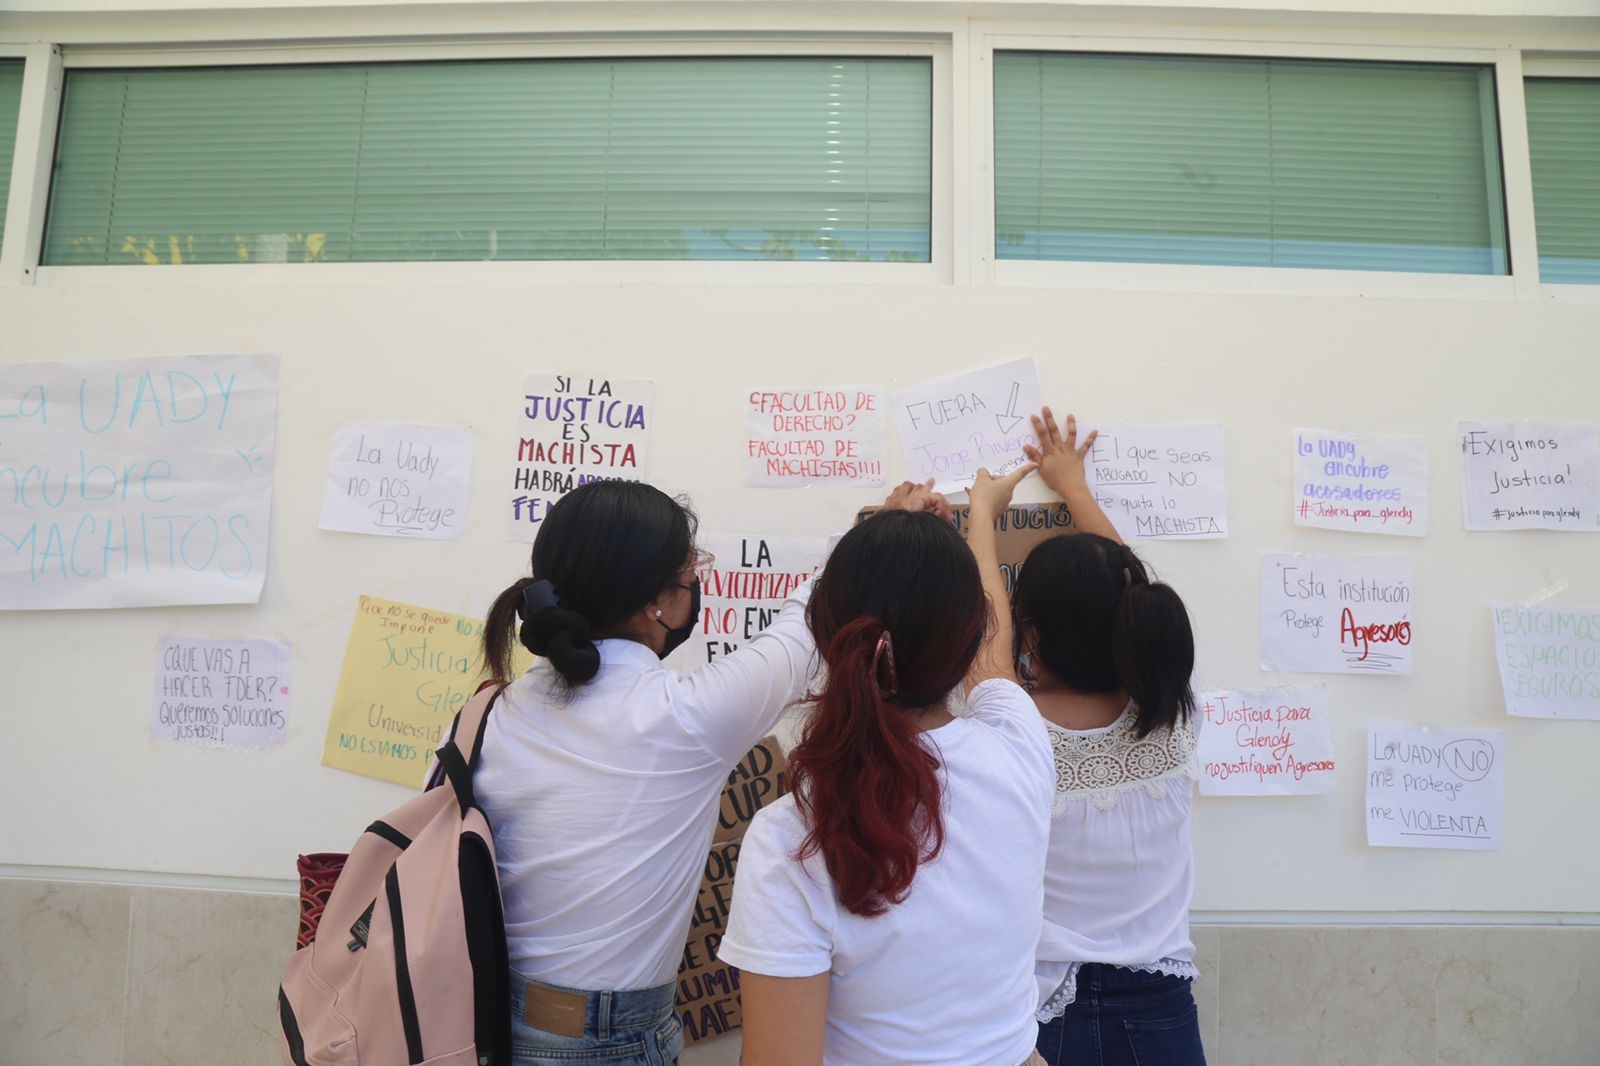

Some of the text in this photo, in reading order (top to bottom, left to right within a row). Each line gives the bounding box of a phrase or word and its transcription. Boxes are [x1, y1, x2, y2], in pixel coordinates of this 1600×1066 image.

[554, 375, 612, 397] SI LA
[79, 370, 236, 435] UADY
[524, 395, 646, 430] JUSTICIA
[855, 391, 877, 411] DE
[905, 391, 987, 431] FUERA
[562, 423, 590, 443] ES
[773, 413, 857, 433] DERECHO?
[356, 433, 381, 465] La
[517, 437, 637, 468] MACHISTA
[748, 439, 859, 458] FACULTAD DE
[1126, 446, 1160, 467] que
[1298, 434, 1313, 457] La
[911, 442, 973, 477] Jorge
[1324, 455, 1390, 480] encubre
[347, 476, 410, 498] no nos
[514, 467, 576, 494] HABRÁ
[1095, 467, 1198, 488] ABOGADO NO
[1120, 494, 1153, 516] quita
[1161, 495, 1177, 511] lo
[1303, 483, 1402, 502] acosadores
[368, 495, 456, 532] Protege
[1135, 515, 1222, 536] MACHISTA
[741, 539, 772, 567] LA
[1283, 567, 1410, 603] Esta institución
[704, 607, 738, 635] NO
[1280, 609, 1325, 638] Protege
[203, 647, 233, 674] VAS
[239, 648, 249, 674] A
[378, 634, 470, 674] Justicia
[164, 675, 213, 698] HACER
[160, 700, 220, 726] Queremos
[1275, 705, 1312, 729] para
[339, 733, 358, 751] NO
[1236, 723, 1295, 761] Glendy
[1374, 733, 1489, 772] La UADY NO
[1371, 770, 1394, 789] me
[1371, 806, 1488, 835] me VIOLENTA
